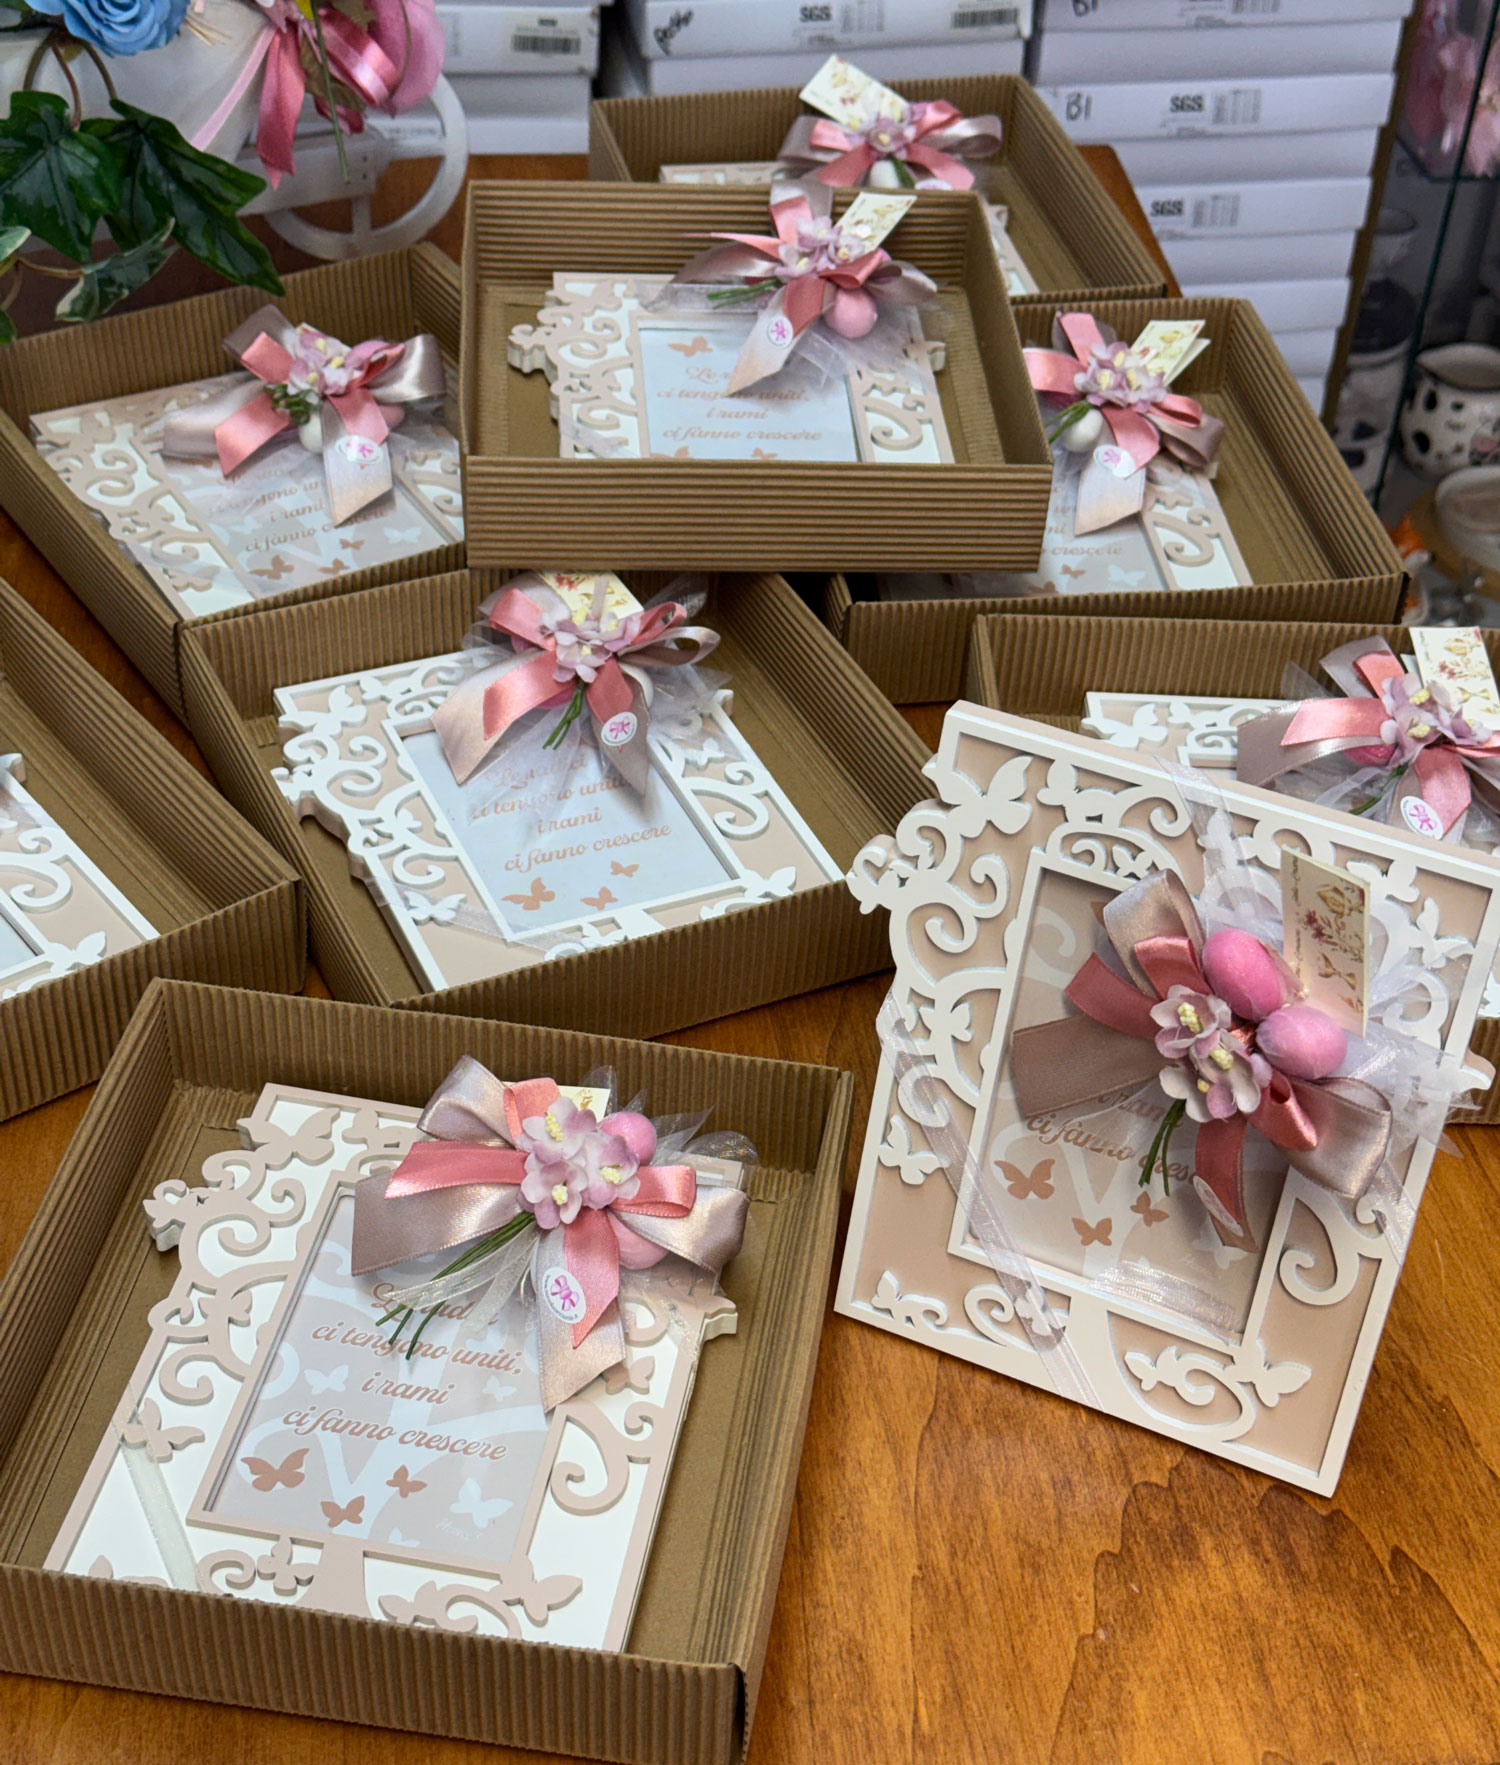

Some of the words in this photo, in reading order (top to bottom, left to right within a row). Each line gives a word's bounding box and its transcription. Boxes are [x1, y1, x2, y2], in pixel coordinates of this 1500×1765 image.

[800, 6, 832, 22] SGS
[1169, 95, 1204, 112] SGS
[1150, 199, 1183, 217] SGS
[716, 408, 769, 420] rami
[663, 425, 682, 439] ci
[678, 426, 743, 442] fanno
[746, 429, 823, 442] crescere
[263, 526, 317, 551] fanno
[1051, 546, 1123, 557] crescere
[549, 806, 603, 832] rami
[504, 853, 521, 872] ci
[517, 844, 588, 874] fanno
[593, 824, 673, 853] crescere
[1026, 1113, 1056, 1134] ci
[311, 1321, 344, 1342] ci
[451, 1347, 523, 1375] uniti,
[361, 1371, 382, 1393] i
[375, 1379, 456, 1405] rami
[282, 1405, 317, 1427] ci
[293, 1408, 397, 1441] fanno
[399, 1427, 508, 1460] crescere
